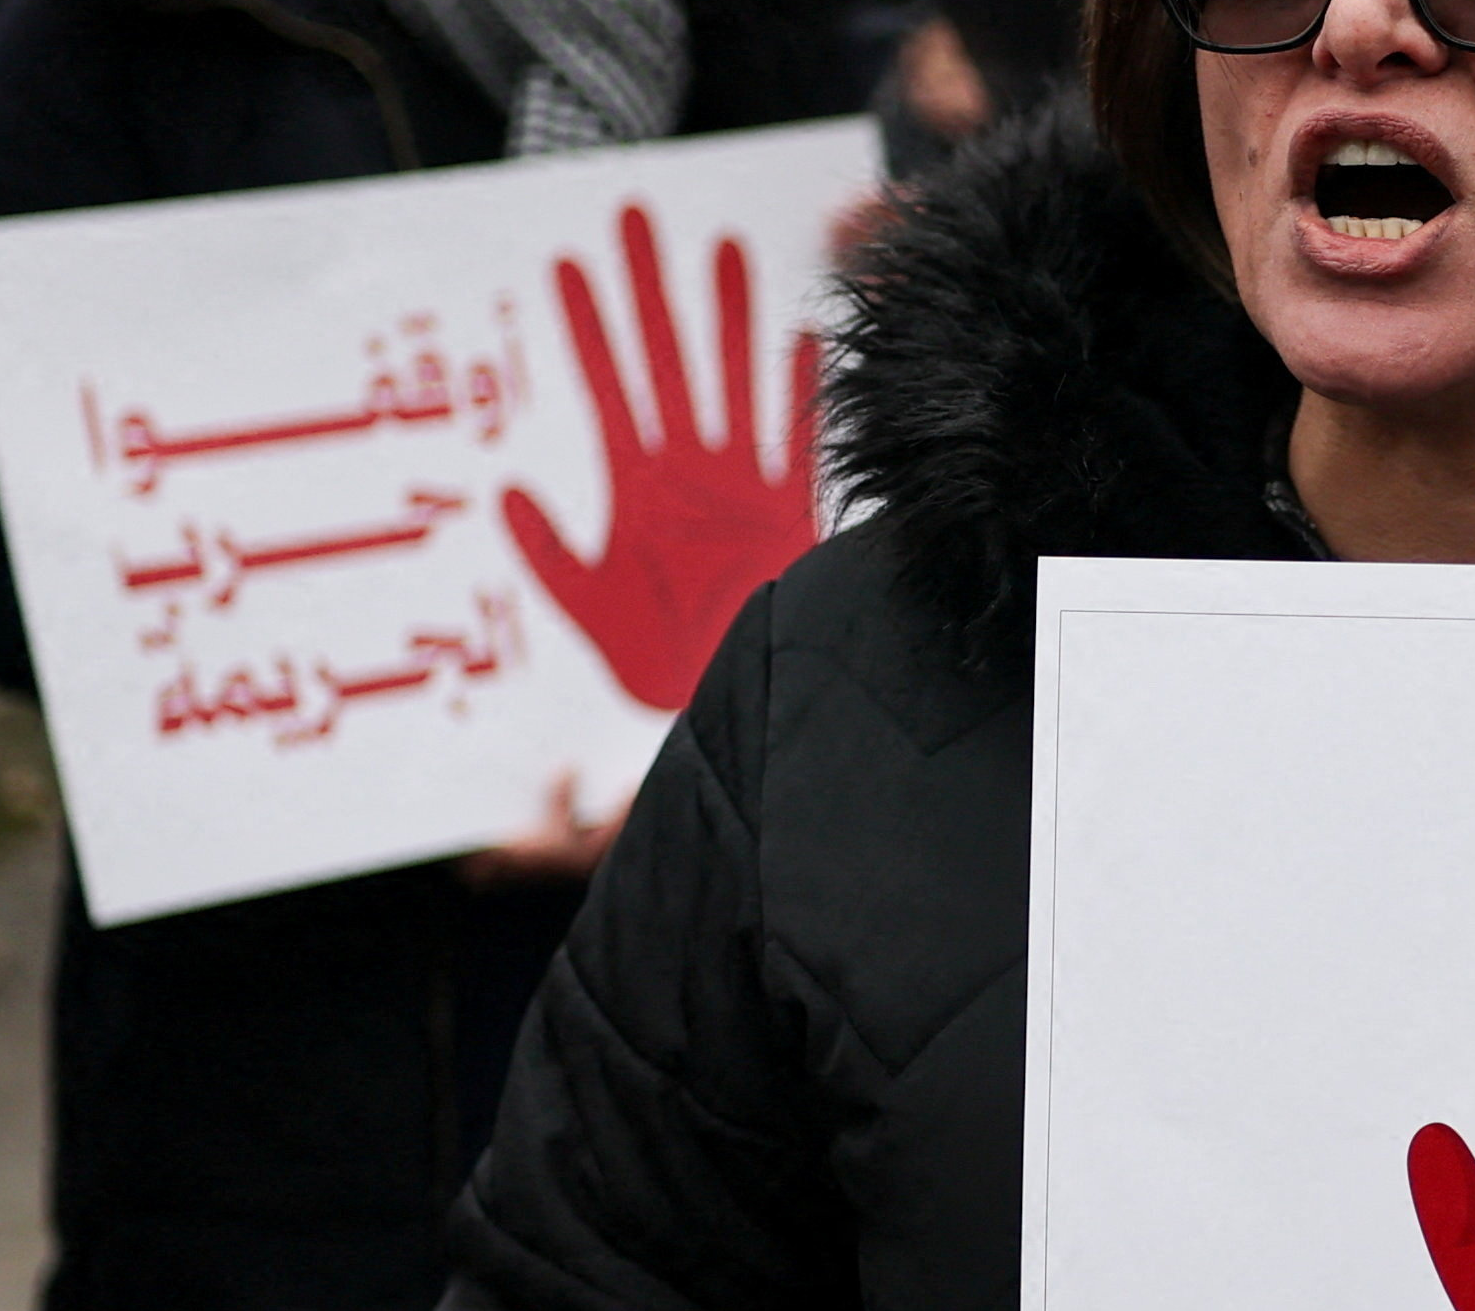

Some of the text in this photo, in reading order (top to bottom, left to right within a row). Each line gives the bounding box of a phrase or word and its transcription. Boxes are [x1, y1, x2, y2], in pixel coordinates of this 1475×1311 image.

[79, 289, 530, 495] أوقفوا
[115, 482, 469, 623] حرب
[152, 586, 529, 749] الجريمة
